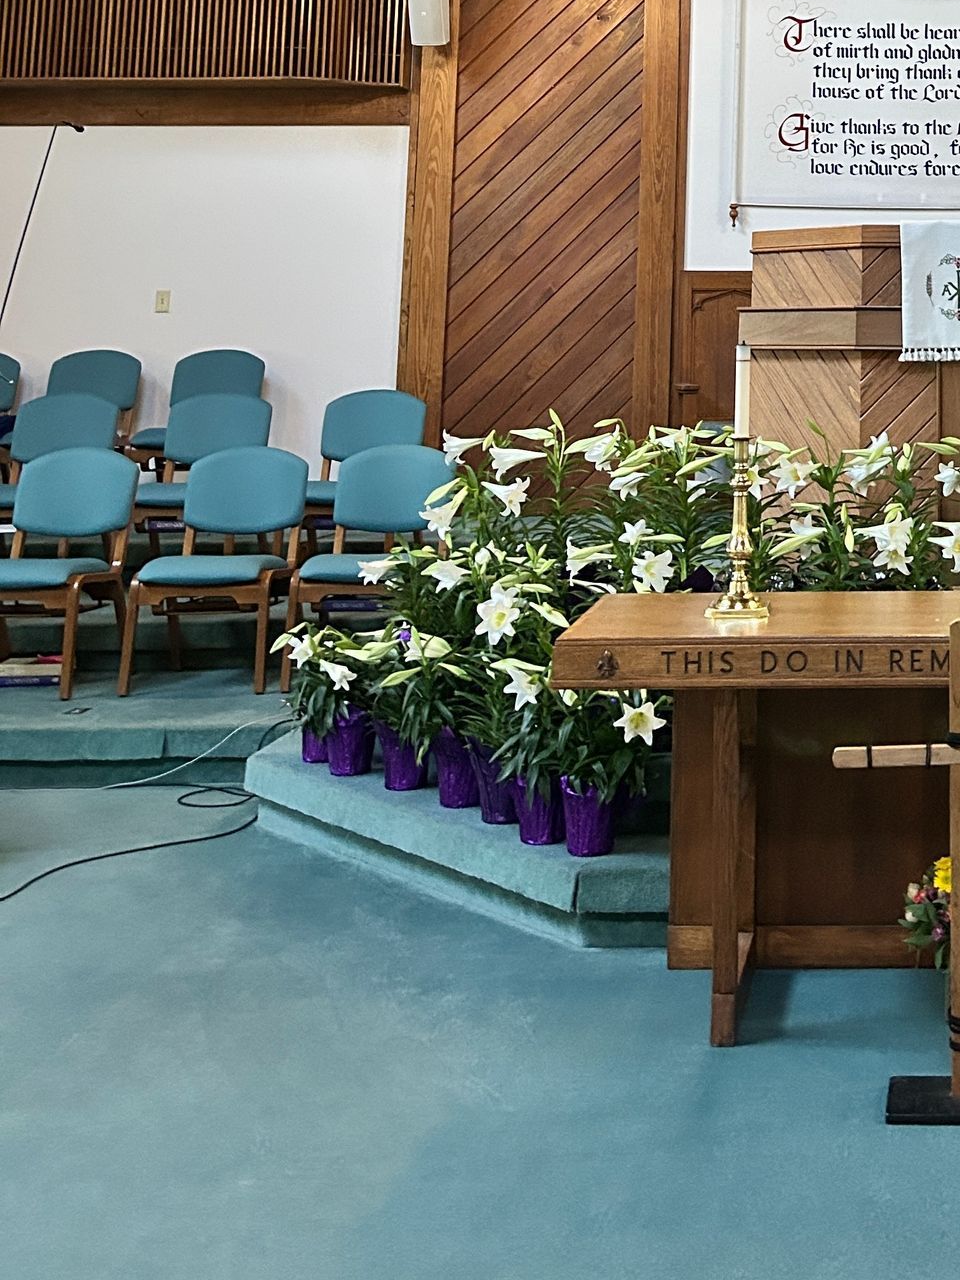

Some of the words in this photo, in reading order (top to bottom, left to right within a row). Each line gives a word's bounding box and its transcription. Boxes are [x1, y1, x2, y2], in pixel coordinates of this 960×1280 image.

[780, 16, 852, 52] There
[857, 22, 896, 39] shall
[900, 23, 920, 40] be
[812, 42, 833, 58] of
[836, 43, 879, 59] mirth
[884, 44, 913, 60] and
[813, 62, 851, 83] they
[856, 63, 899, 84] bring
[905, 64, 952, 80] thank
[812, 82, 860, 100] house
[865, 83, 885, 100] of
[890, 84, 918, 100] the
[778, 113, 834, 152] Give
[840, 118, 896, 135] thanks
[902, 120, 920, 135] to
[924, 119, 952, 136] the
[811, 137, 838, 154] for
[843, 138, 866, 158] He
[871, 140, 886, 155] is
[810, 158, 844, 174] love
[849, 160, 918, 177] endures
[661, 650, 735, 674] THIS
[760, 650, 808, 674] DO
[834, 650, 864, 673] IN
